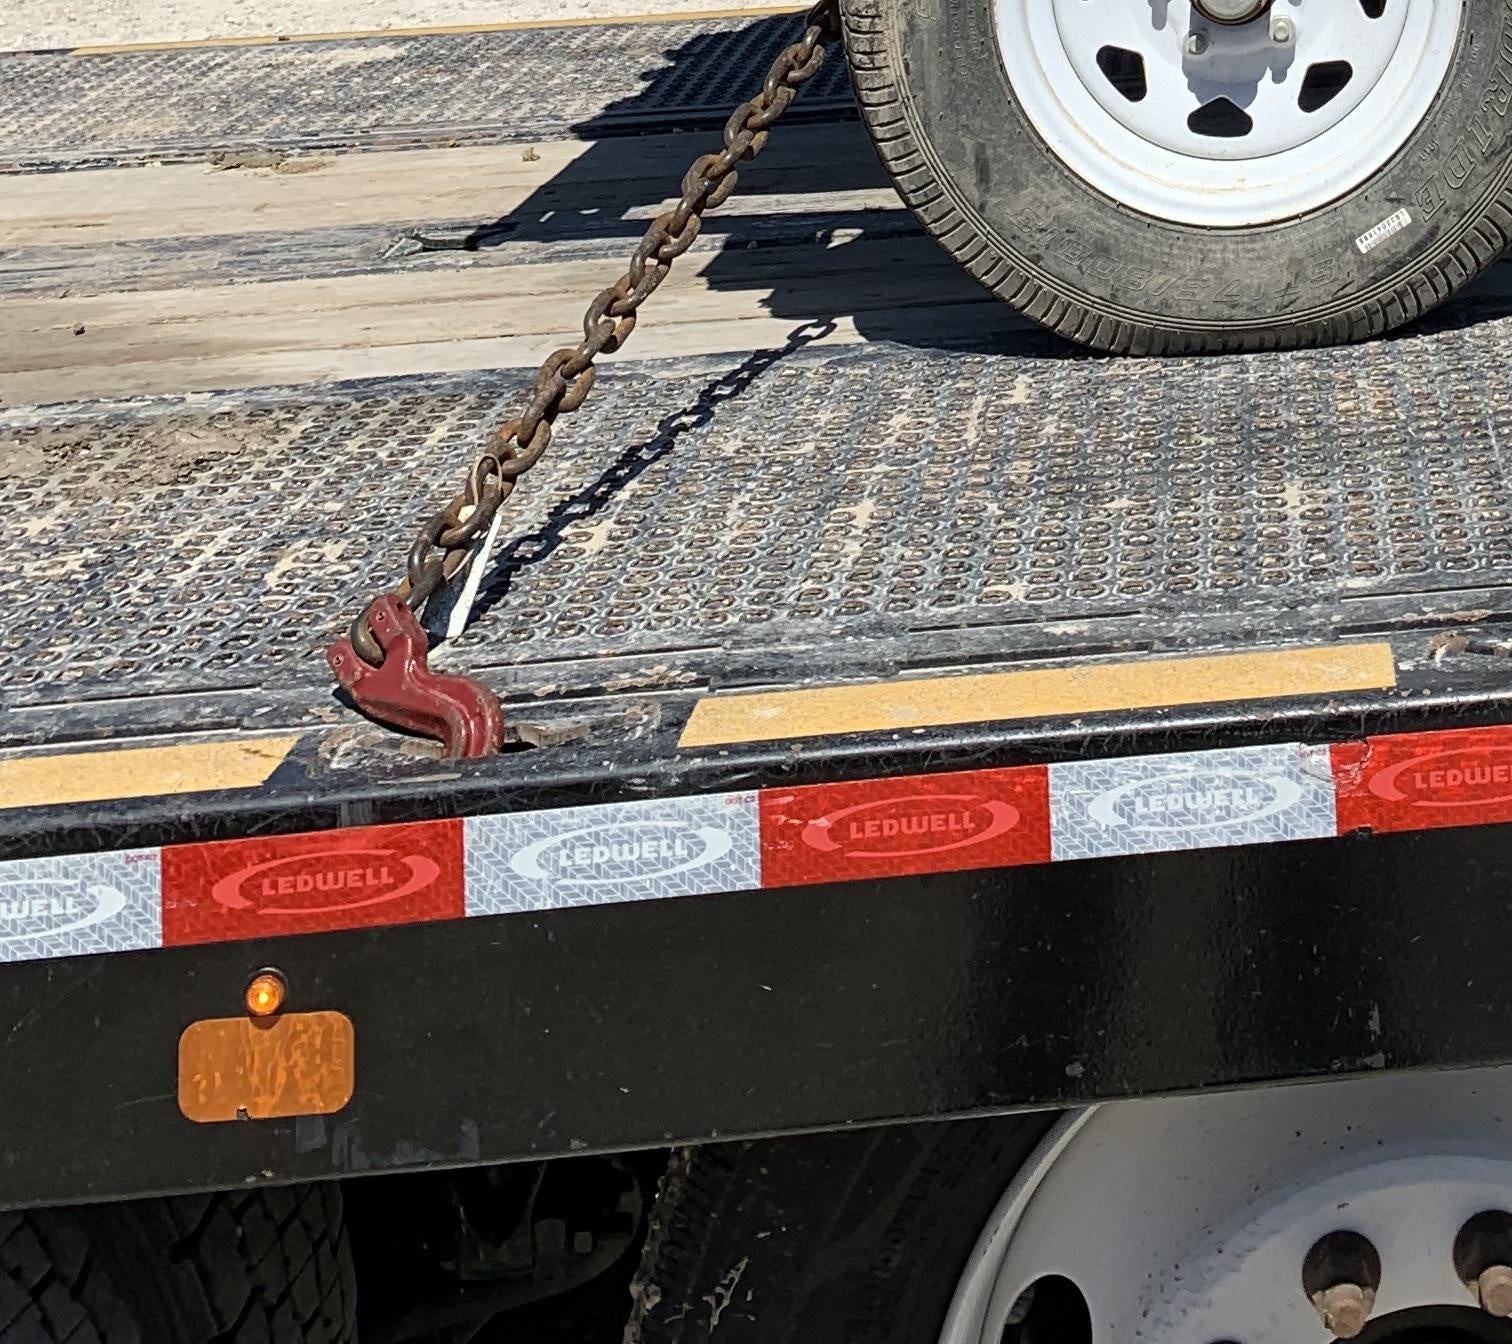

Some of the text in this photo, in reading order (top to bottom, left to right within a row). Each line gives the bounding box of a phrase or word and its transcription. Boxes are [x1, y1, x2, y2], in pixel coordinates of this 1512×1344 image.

[1134, 782, 1262, 815] LEDWELL
[849, 809, 977, 839] LEDWELL
[559, 835, 689, 868] LEDWELL
[262, 869, 394, 897] LEDWELL
[0, 896, 79, 920] WELL
